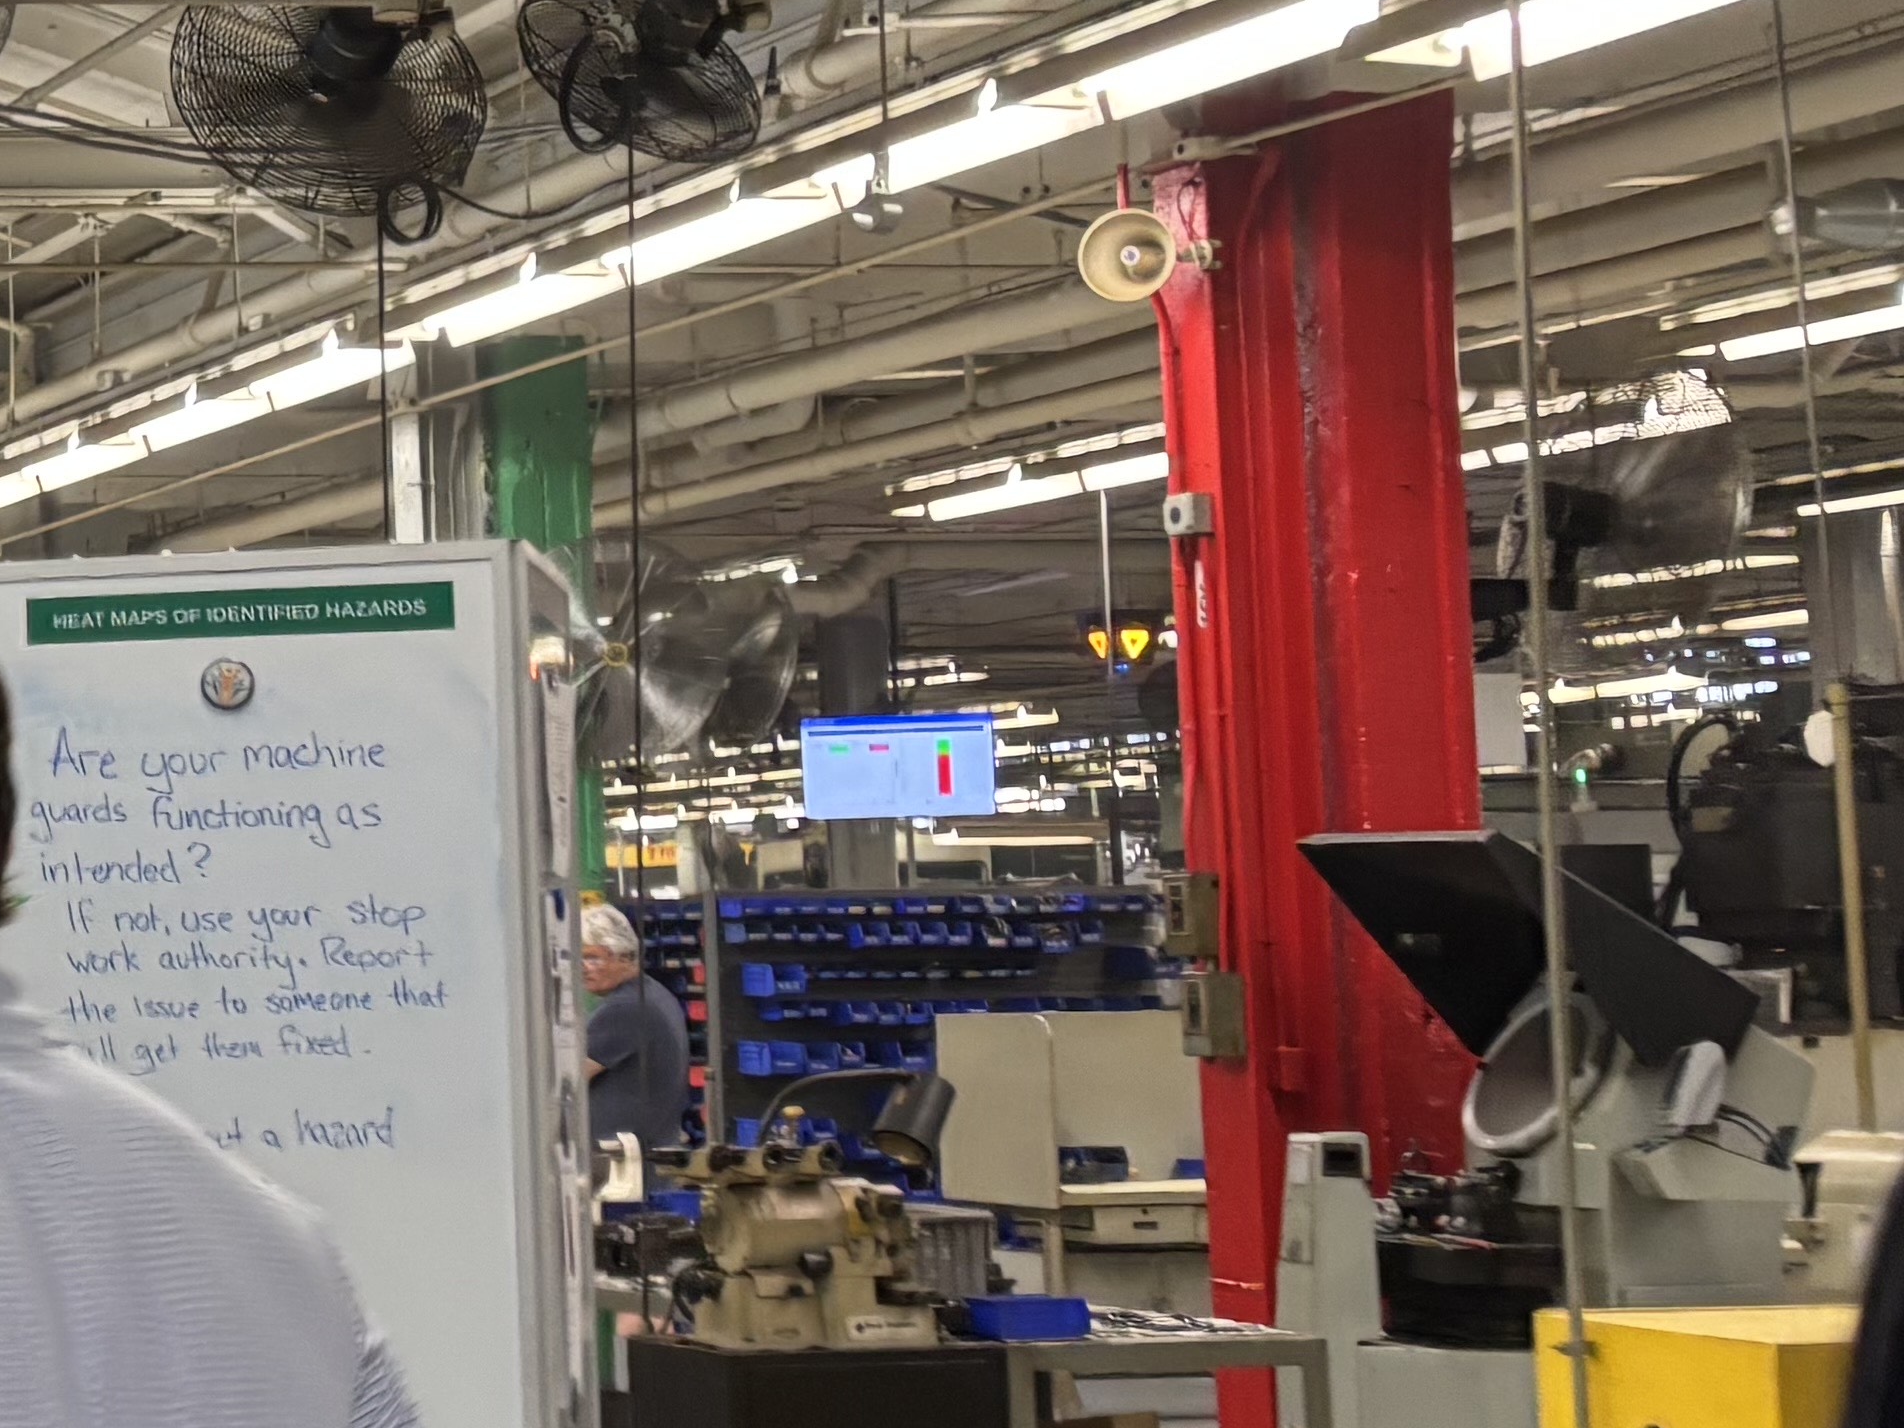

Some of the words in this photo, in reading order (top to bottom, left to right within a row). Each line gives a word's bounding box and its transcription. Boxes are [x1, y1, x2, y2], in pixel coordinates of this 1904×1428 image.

[52, 610, 105, 630] HEAT
[110, 608, 168, 627] MAPS
[172, 606, 201, 625] OF
[205, 602, 320, 624] IDENTIFIED
[325, 597, 427, 619] HAZARDS
[50, 725, 119, 780] Are
[140, 749, 229, 795] your
[242, 730, 387, 772] machine
[29, 792, 129, 844] guards
[152, 794, 333, 849] functioning
[336, 803, 382, 831] as
[67, 897, 95, 934] If
[180, 908, 234, 934] use
[247, 904, 322, 943] your
[345, 892, 428, 937] stop
[67, 938, 141, 974] work
[319, 935, 435, 976] Report
[64, 988, 118, 1024] the
[214, 984, 249, 1016] to
[265, 989, 373, 1015] someone
[386, 977, 450, 1010] that
[134, 1032, 180, 1077] get
[201, 1029, 264, 1060] them
[260, 1127, 285, 1153] a
[293, 1105, 396, 1150] hazard
